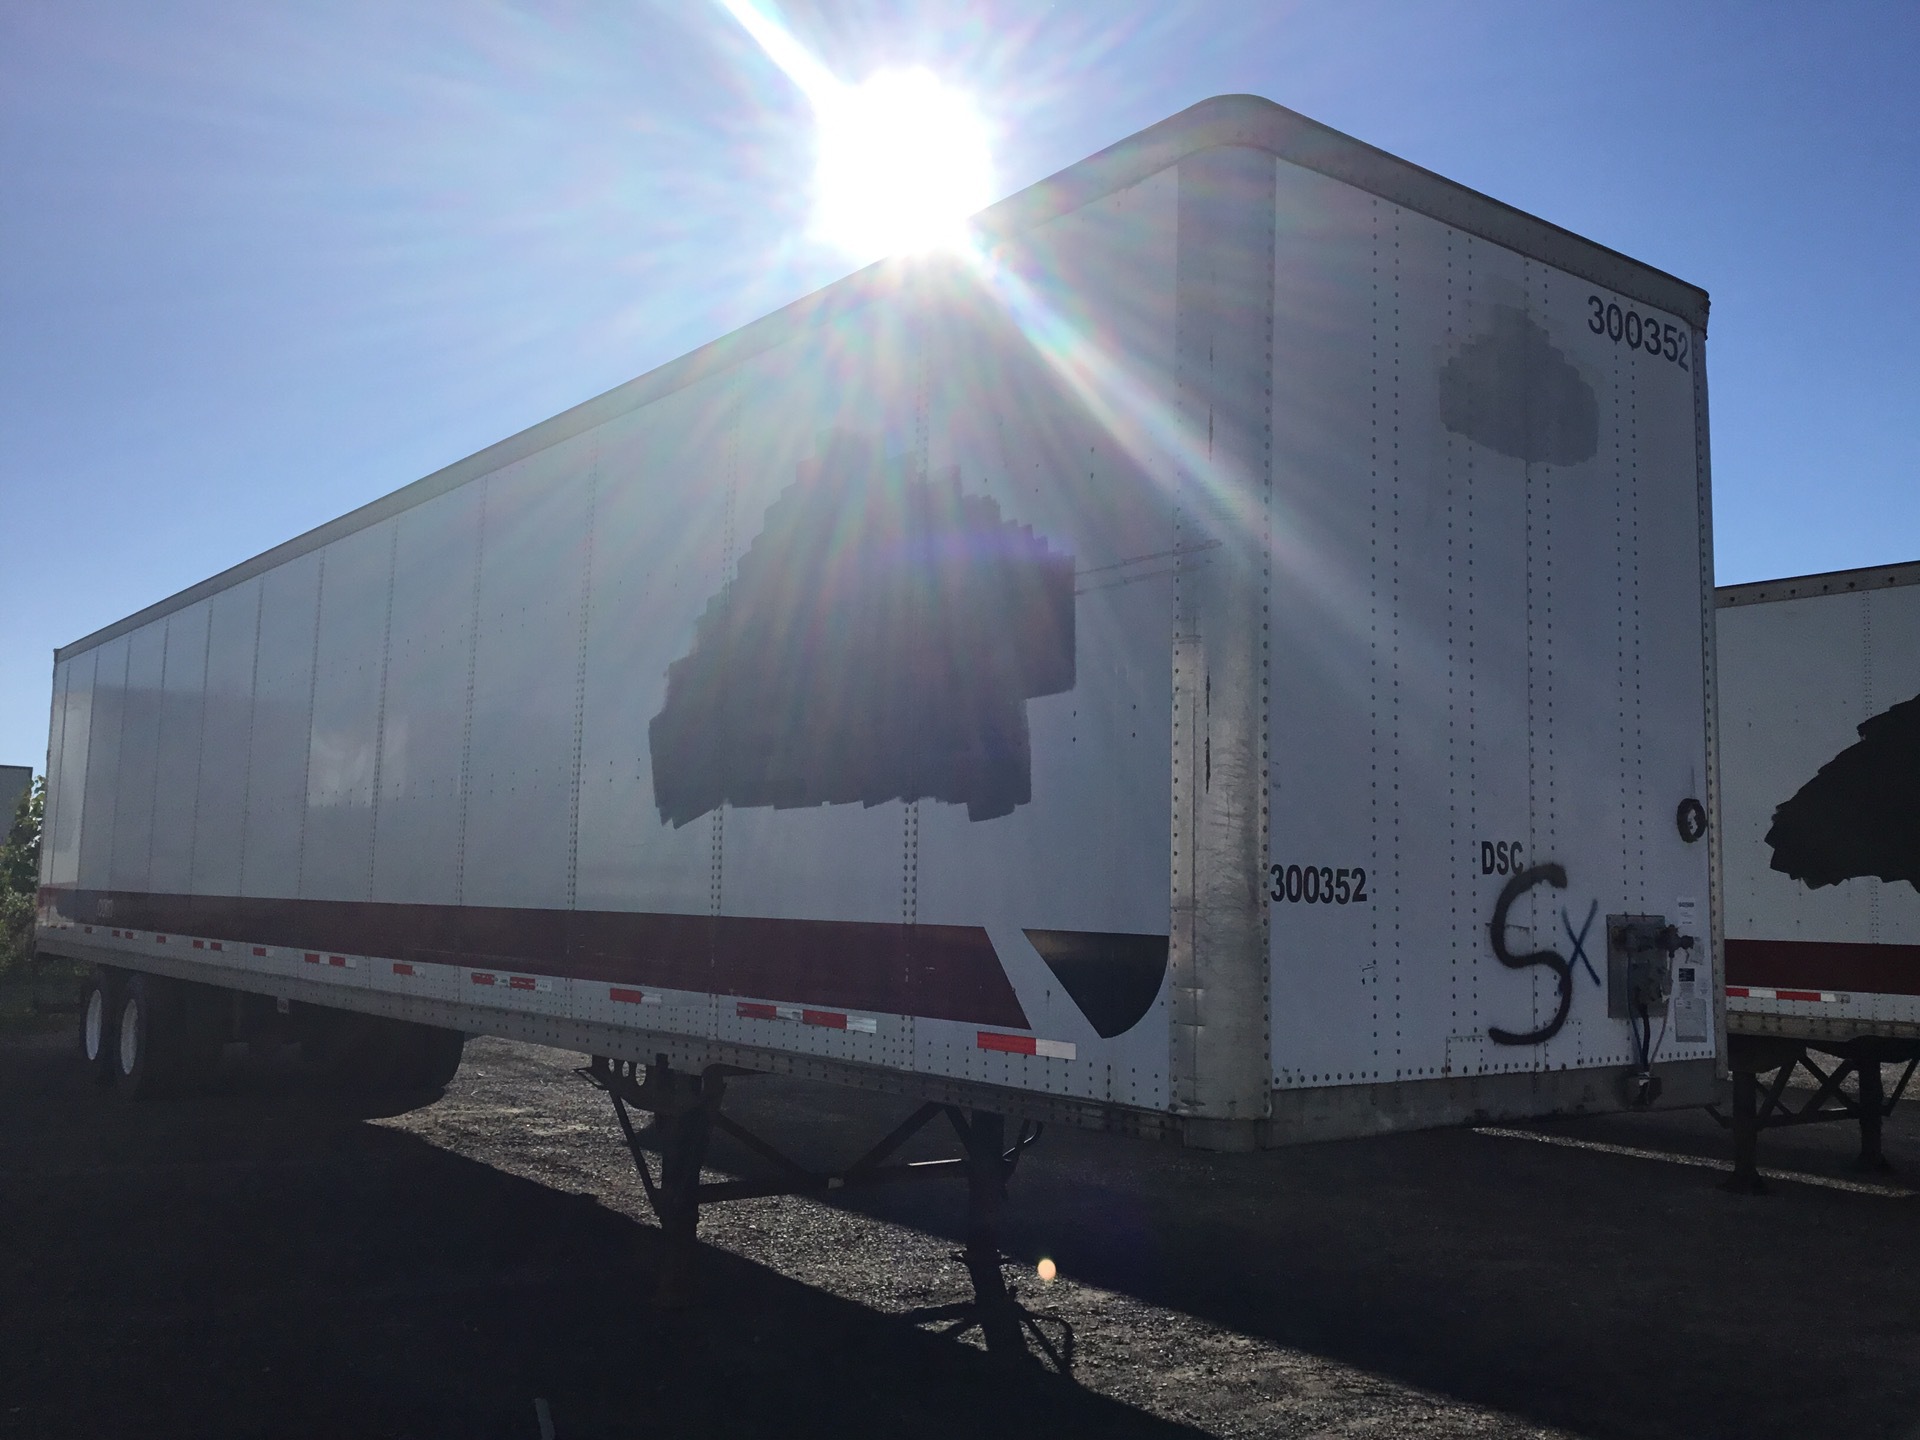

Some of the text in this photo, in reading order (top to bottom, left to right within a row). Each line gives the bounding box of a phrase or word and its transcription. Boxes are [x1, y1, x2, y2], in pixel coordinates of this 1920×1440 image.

[1588, 295, 1689, 373] 300352
[1481, 841, 1524, 876] DSC
[1271, 864, 1367, 904] 300352
